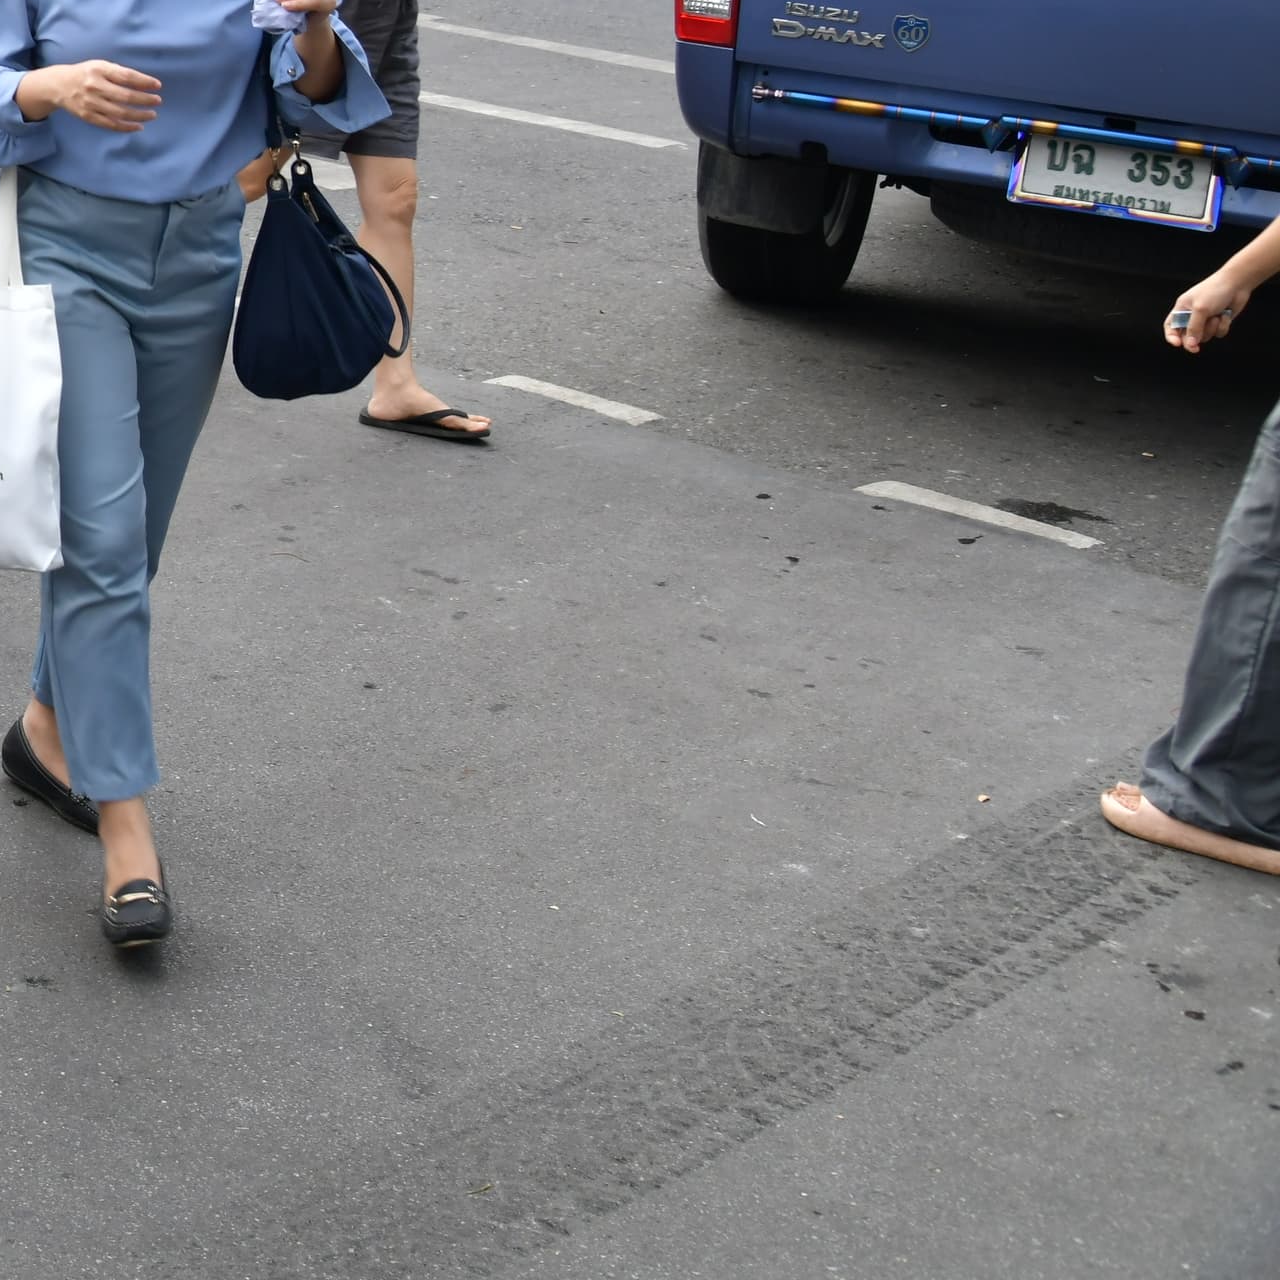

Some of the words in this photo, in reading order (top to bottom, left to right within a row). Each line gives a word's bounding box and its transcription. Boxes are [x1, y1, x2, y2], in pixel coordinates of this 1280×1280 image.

[785, 1, 859, 23] ISUZU
[771, 17, 887, 49] D-MAX
[1046, 139, 1096, 176] บฉ
[1126, 151, 1195, 191] 353
[1052, 183, 1172, 214] สมทรสงคราม
